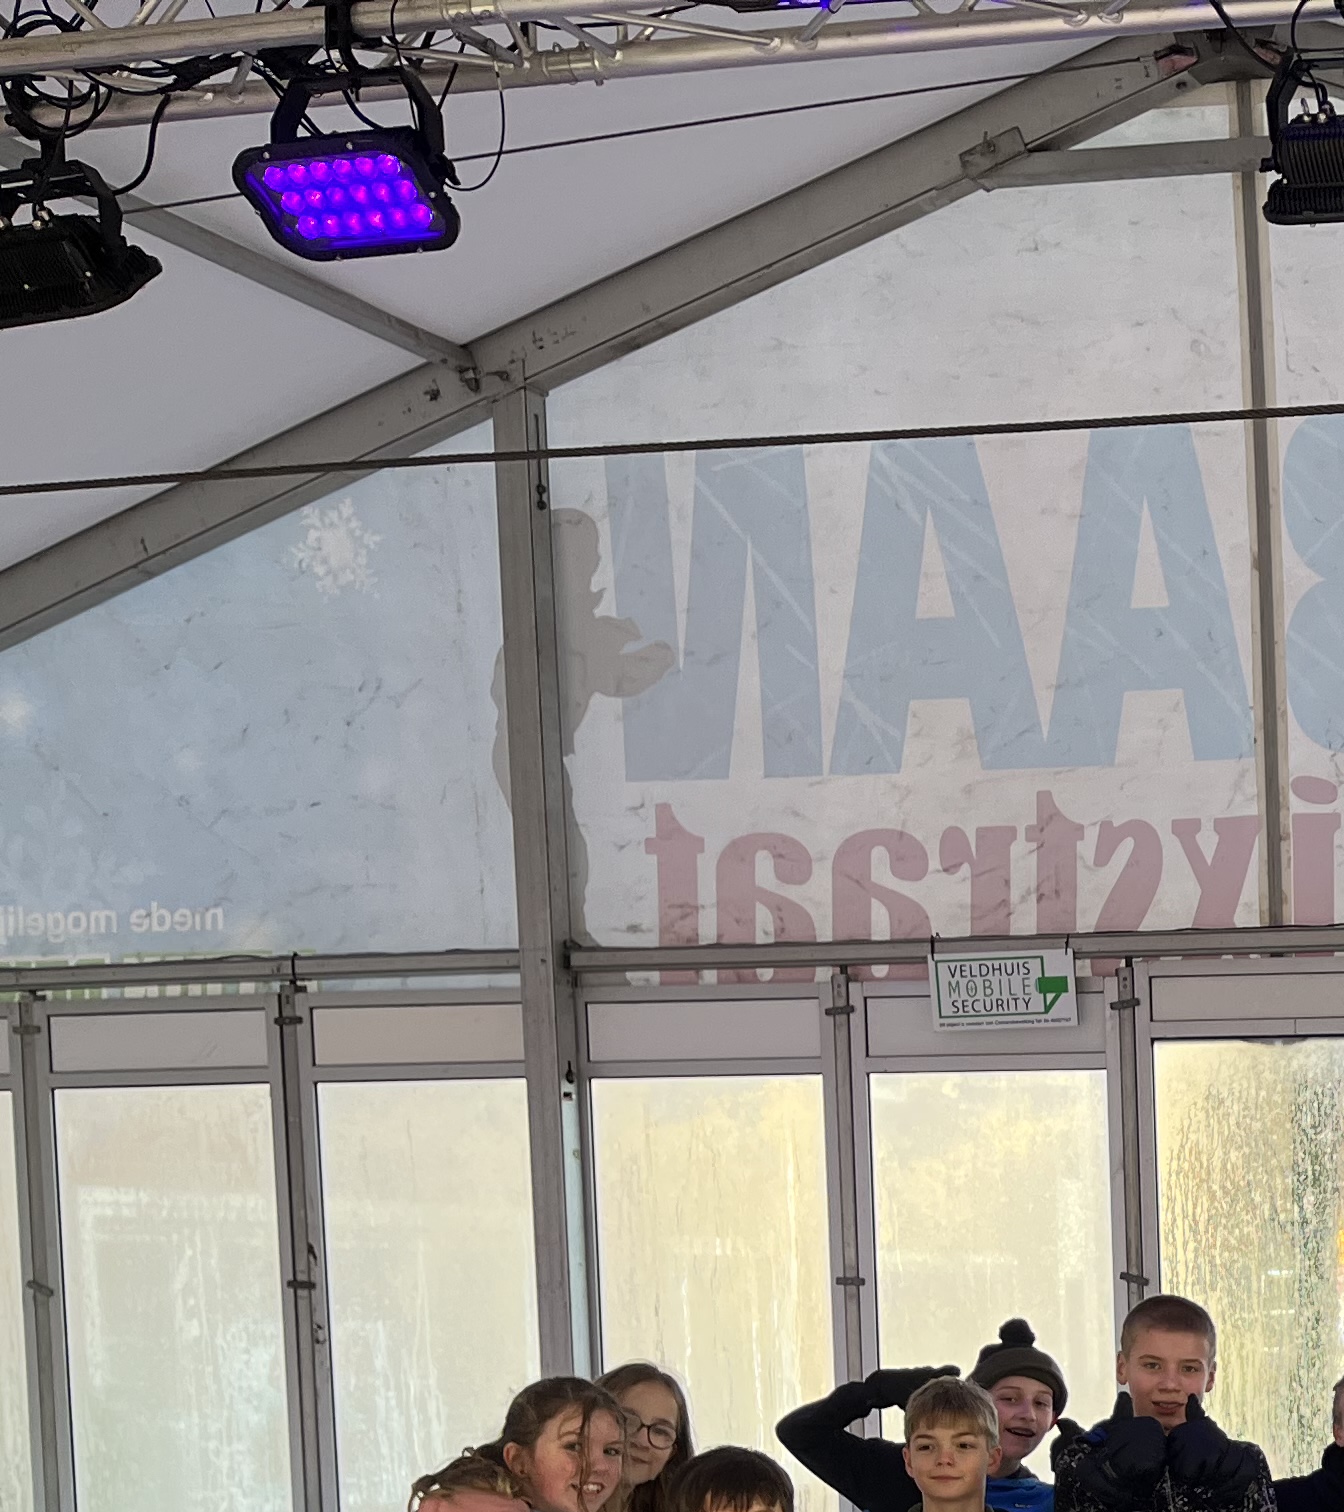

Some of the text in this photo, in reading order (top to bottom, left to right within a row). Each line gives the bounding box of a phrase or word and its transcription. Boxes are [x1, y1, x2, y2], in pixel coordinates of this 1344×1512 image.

[948, 961, 1031, 979] VELDHUIS
[948, 977, 1032, 998] MOBILE
[952, 997, 1032, 1014] SECURITY
